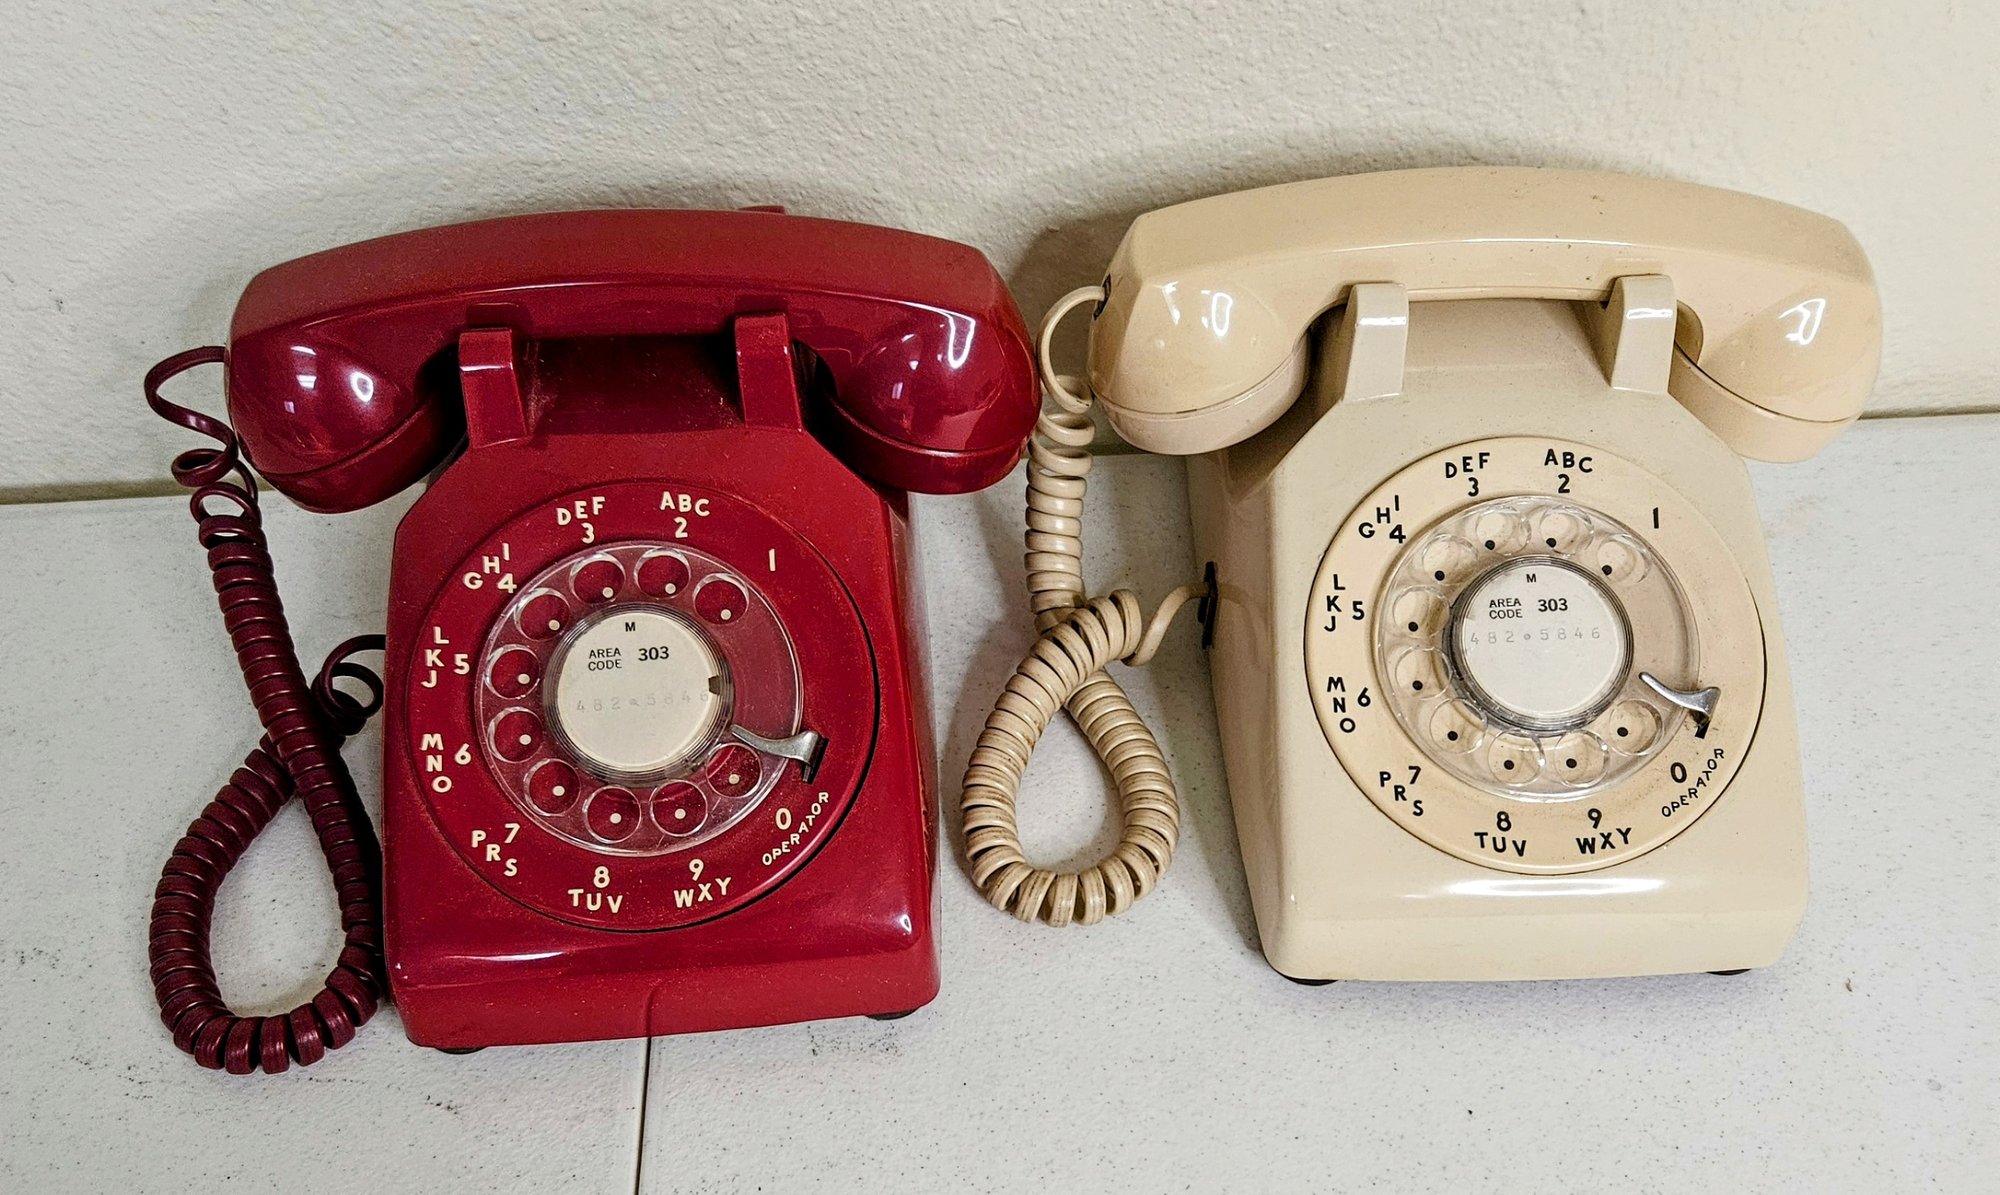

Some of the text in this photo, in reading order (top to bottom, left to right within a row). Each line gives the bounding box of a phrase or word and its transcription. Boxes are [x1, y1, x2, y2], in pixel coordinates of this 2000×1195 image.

[1445, 452, 1491, 479] DEF
[1544, 449, 1594, 474] ABC
[1468, 478, 1479, 497] 3
[1557, 473, 1571, 494] 2
[557, 496, 606, 526] DEF
[660, 491, 711, 517] ABC
[674, 517, 689, 538] 2
[1358, 495, 1400, 539] GHI
[582, 523, 596, 544] 3
[1388, 524, 1406, 544] 4
[463, 543, 511, 590] GHI
[497, 573, 517, 595] 4
[1526, 573, 1537, 583] M
[1352, 600, 1364, 621] 5
[1489, 597, 1568, 612] AREA 303
[1489, 608, 1523, 619] CODE
[625, 622, 636, 632] M
[454, 653, 470, 675] 5
[589, 646, 670, 661] AREA 303
[588, 659, 622, 671] CODE
[1357, 687, 1371, 708] 6
[454, 744, 472, 766] 6
[1407, 765, 1422, 786] 7
[1660, 748, 1725, 817] OPERATOR
[761, 791, 829, 867] OPERATOR
[1496, 811, 1512, 832] 8
[1587, 808, 1602, 830] 9
[504, 822, 520, 844] 7
[1474, 831, 1527, 857] TUV
[1576, 826, 1632, 855] WXY
[592, 865, 611, 888] 8
[688, 858, 704, 881] 9
[568, 888, 623, 914] TUV
[673, 876, 732, 909] WXY
